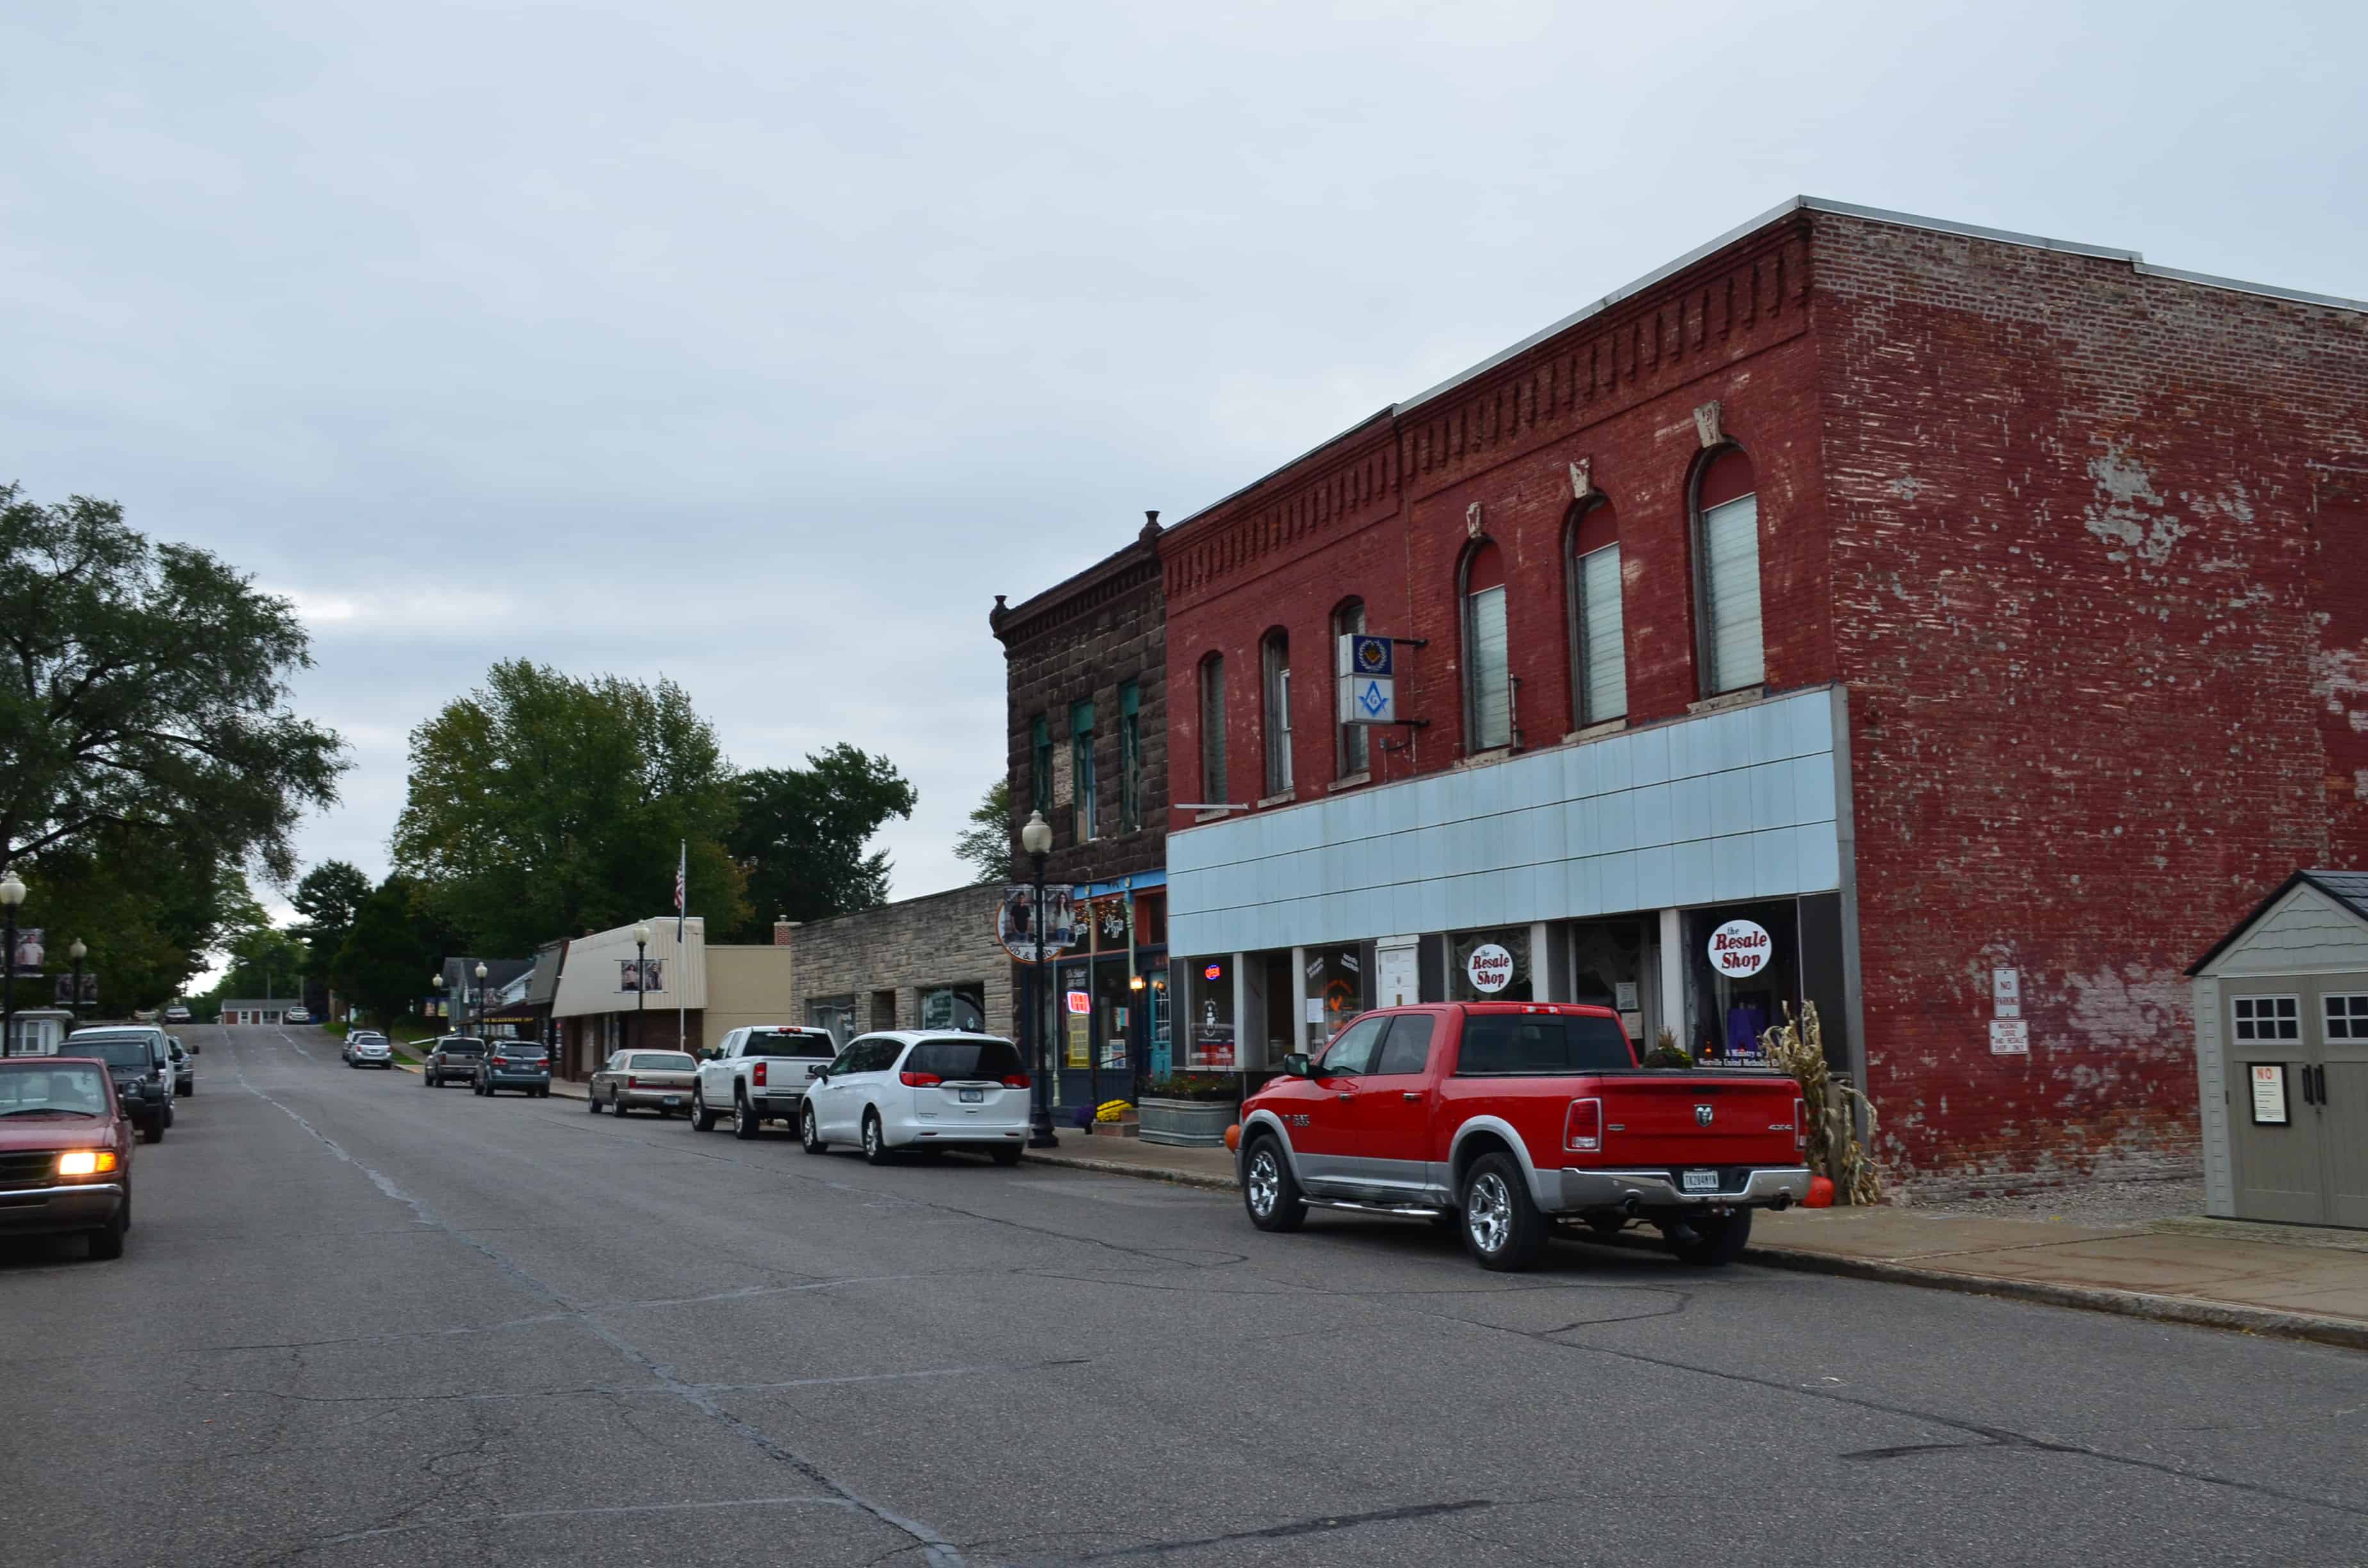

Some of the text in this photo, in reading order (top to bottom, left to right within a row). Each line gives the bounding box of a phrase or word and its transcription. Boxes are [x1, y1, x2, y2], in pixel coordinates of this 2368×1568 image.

[1727, 927, 1740, 935] the
[1714, 931, 1768, 951] Resale
[1023, 951, 1031, 960] &
[1472, 953, 1509, 969] Resale
[1722, 952, 1761, 971] Shop
[1477, 971, 1504, 987] Shop
[2000, 981, 2010, 990] NO
[2256, 1068, 2273, 1079] NO
